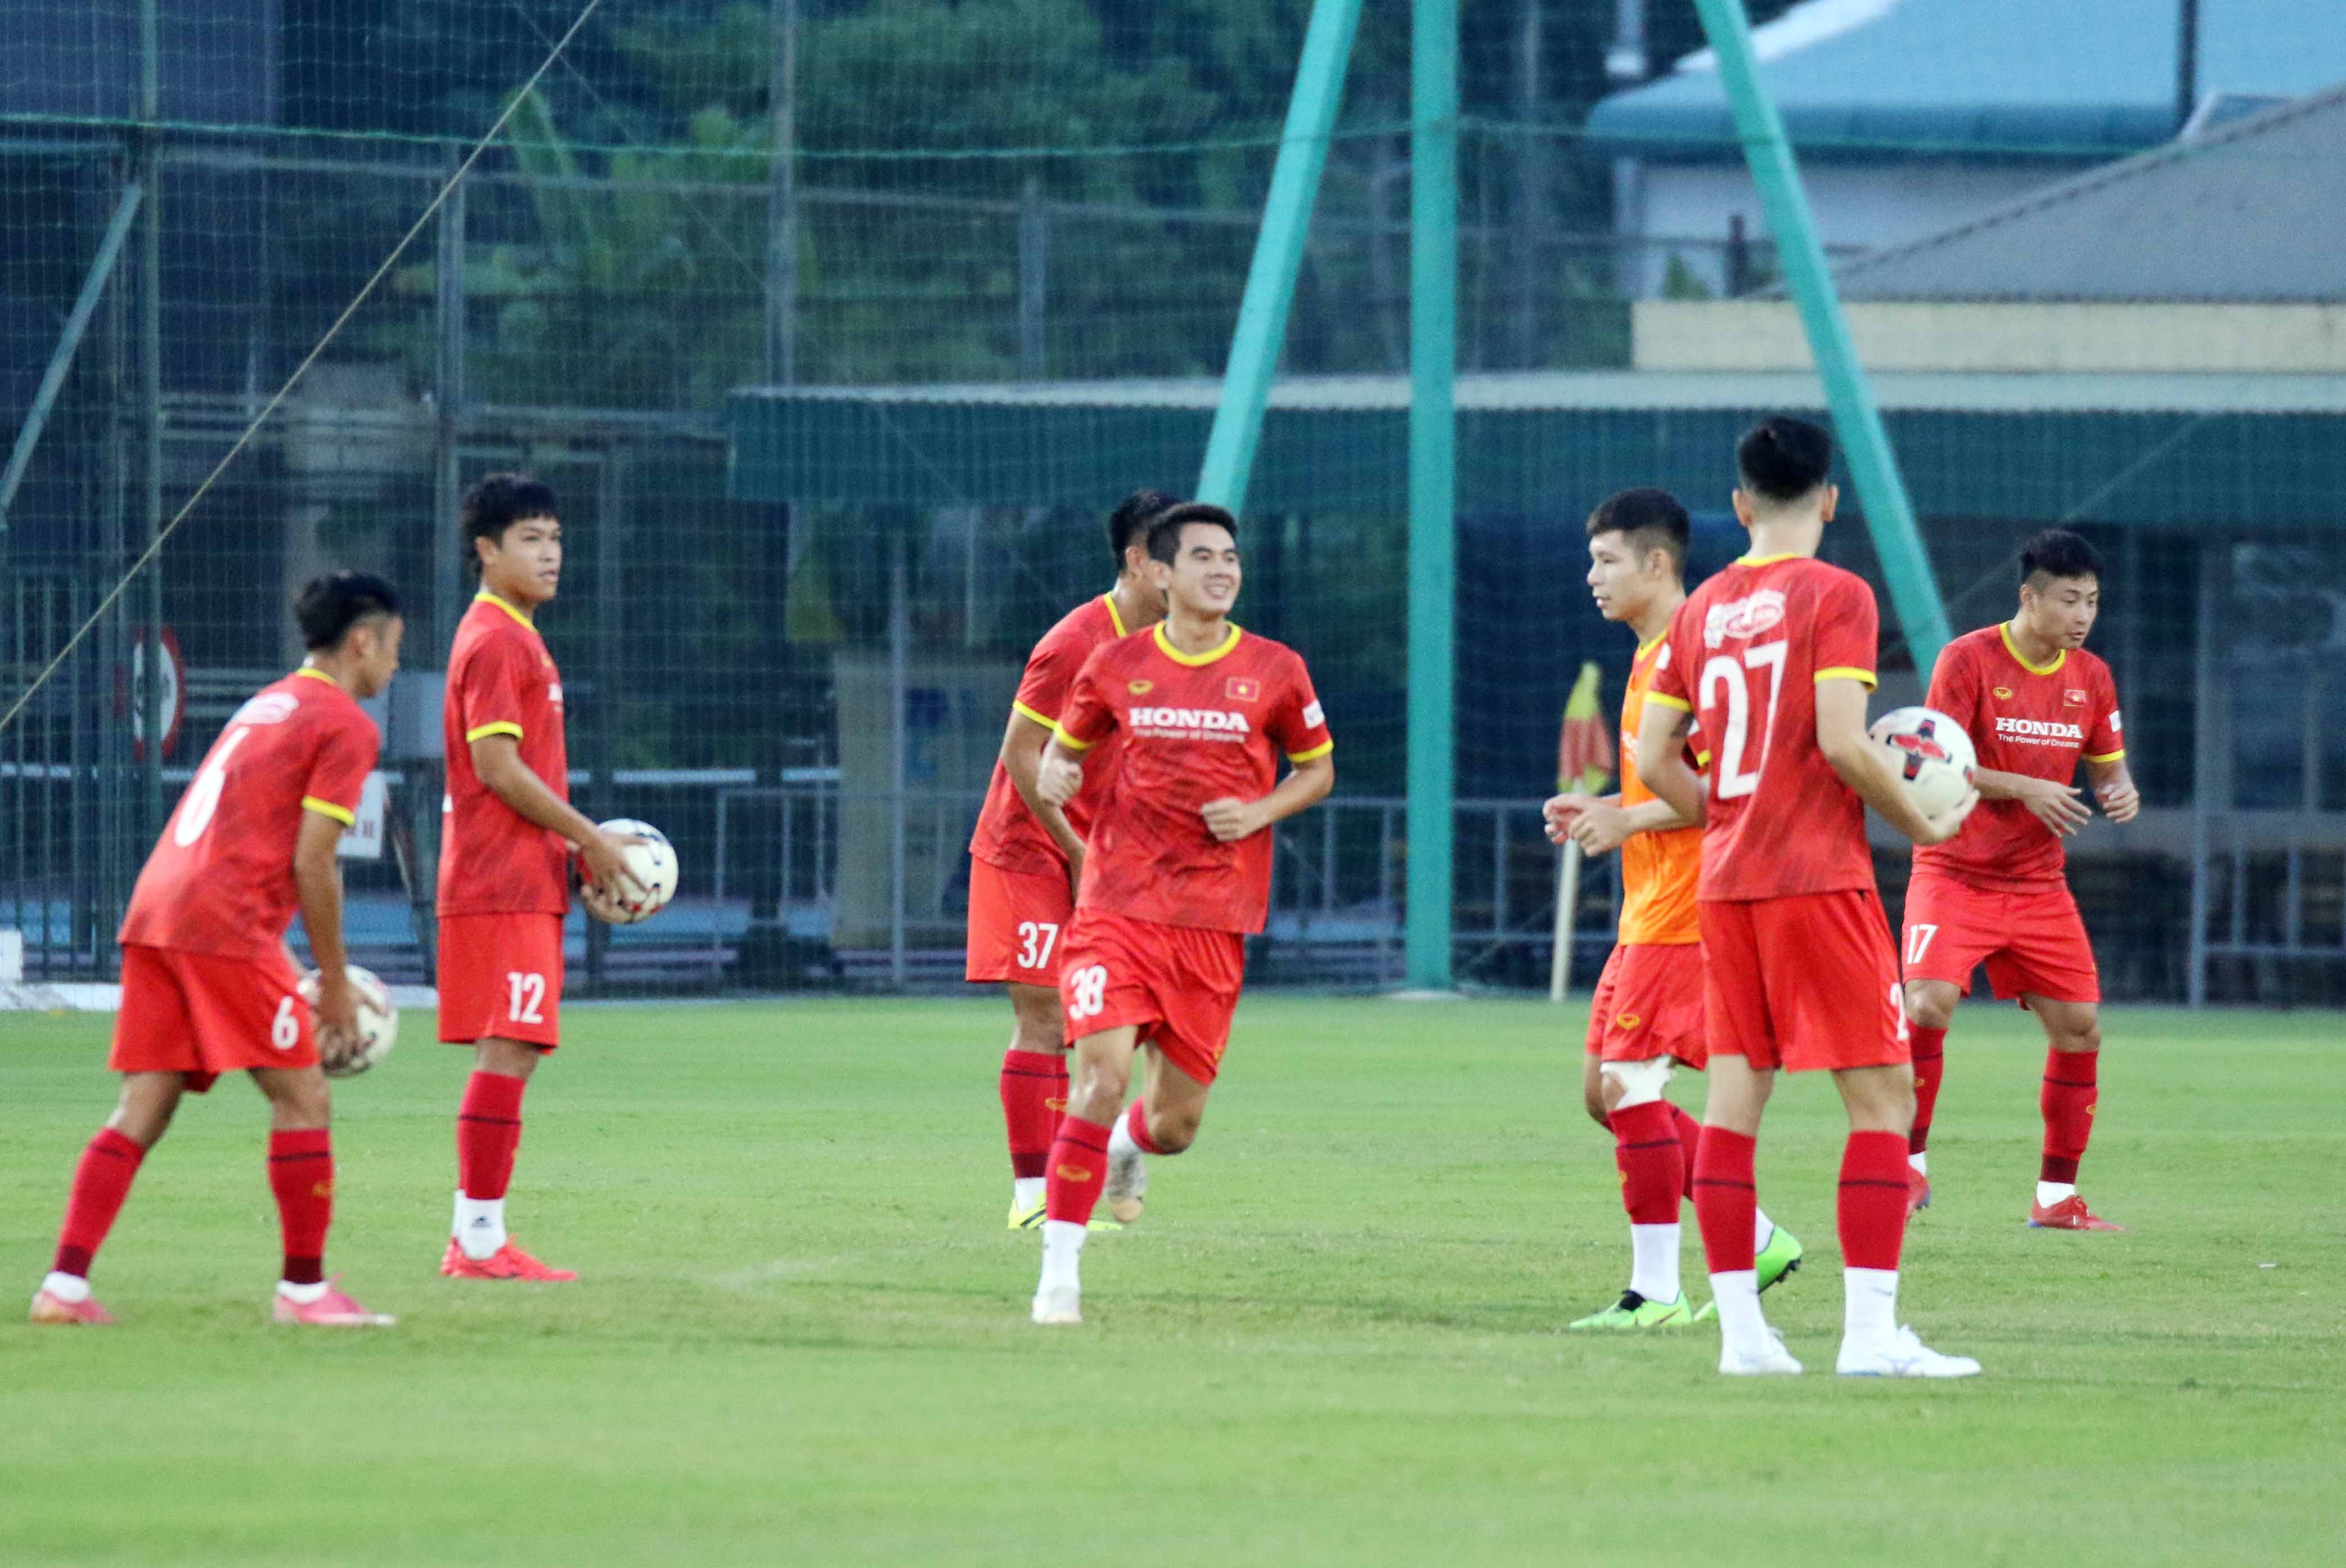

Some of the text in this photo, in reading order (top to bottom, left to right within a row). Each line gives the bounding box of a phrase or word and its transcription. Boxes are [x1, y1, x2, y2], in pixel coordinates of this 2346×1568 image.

[1129, 707, 1250, 733] HONDA
[1699, 640, 1788, 800] 27
[1995, 717, 2083, 739] HONDA
[1998, 733, 2014, 742] The
[2015, 736, 2040, 745] Power
[2051, 739, 2080, 748] Dreams
[175, 727, 251, 847] 6
[1017, 922, 1058, 969] 37
[1907, 924, 1938, 964] 17
[508, 972, 545, 1024] 12
[1069, 965, 1107, 1020] 38
[271, 996, 298, 1050] 6
